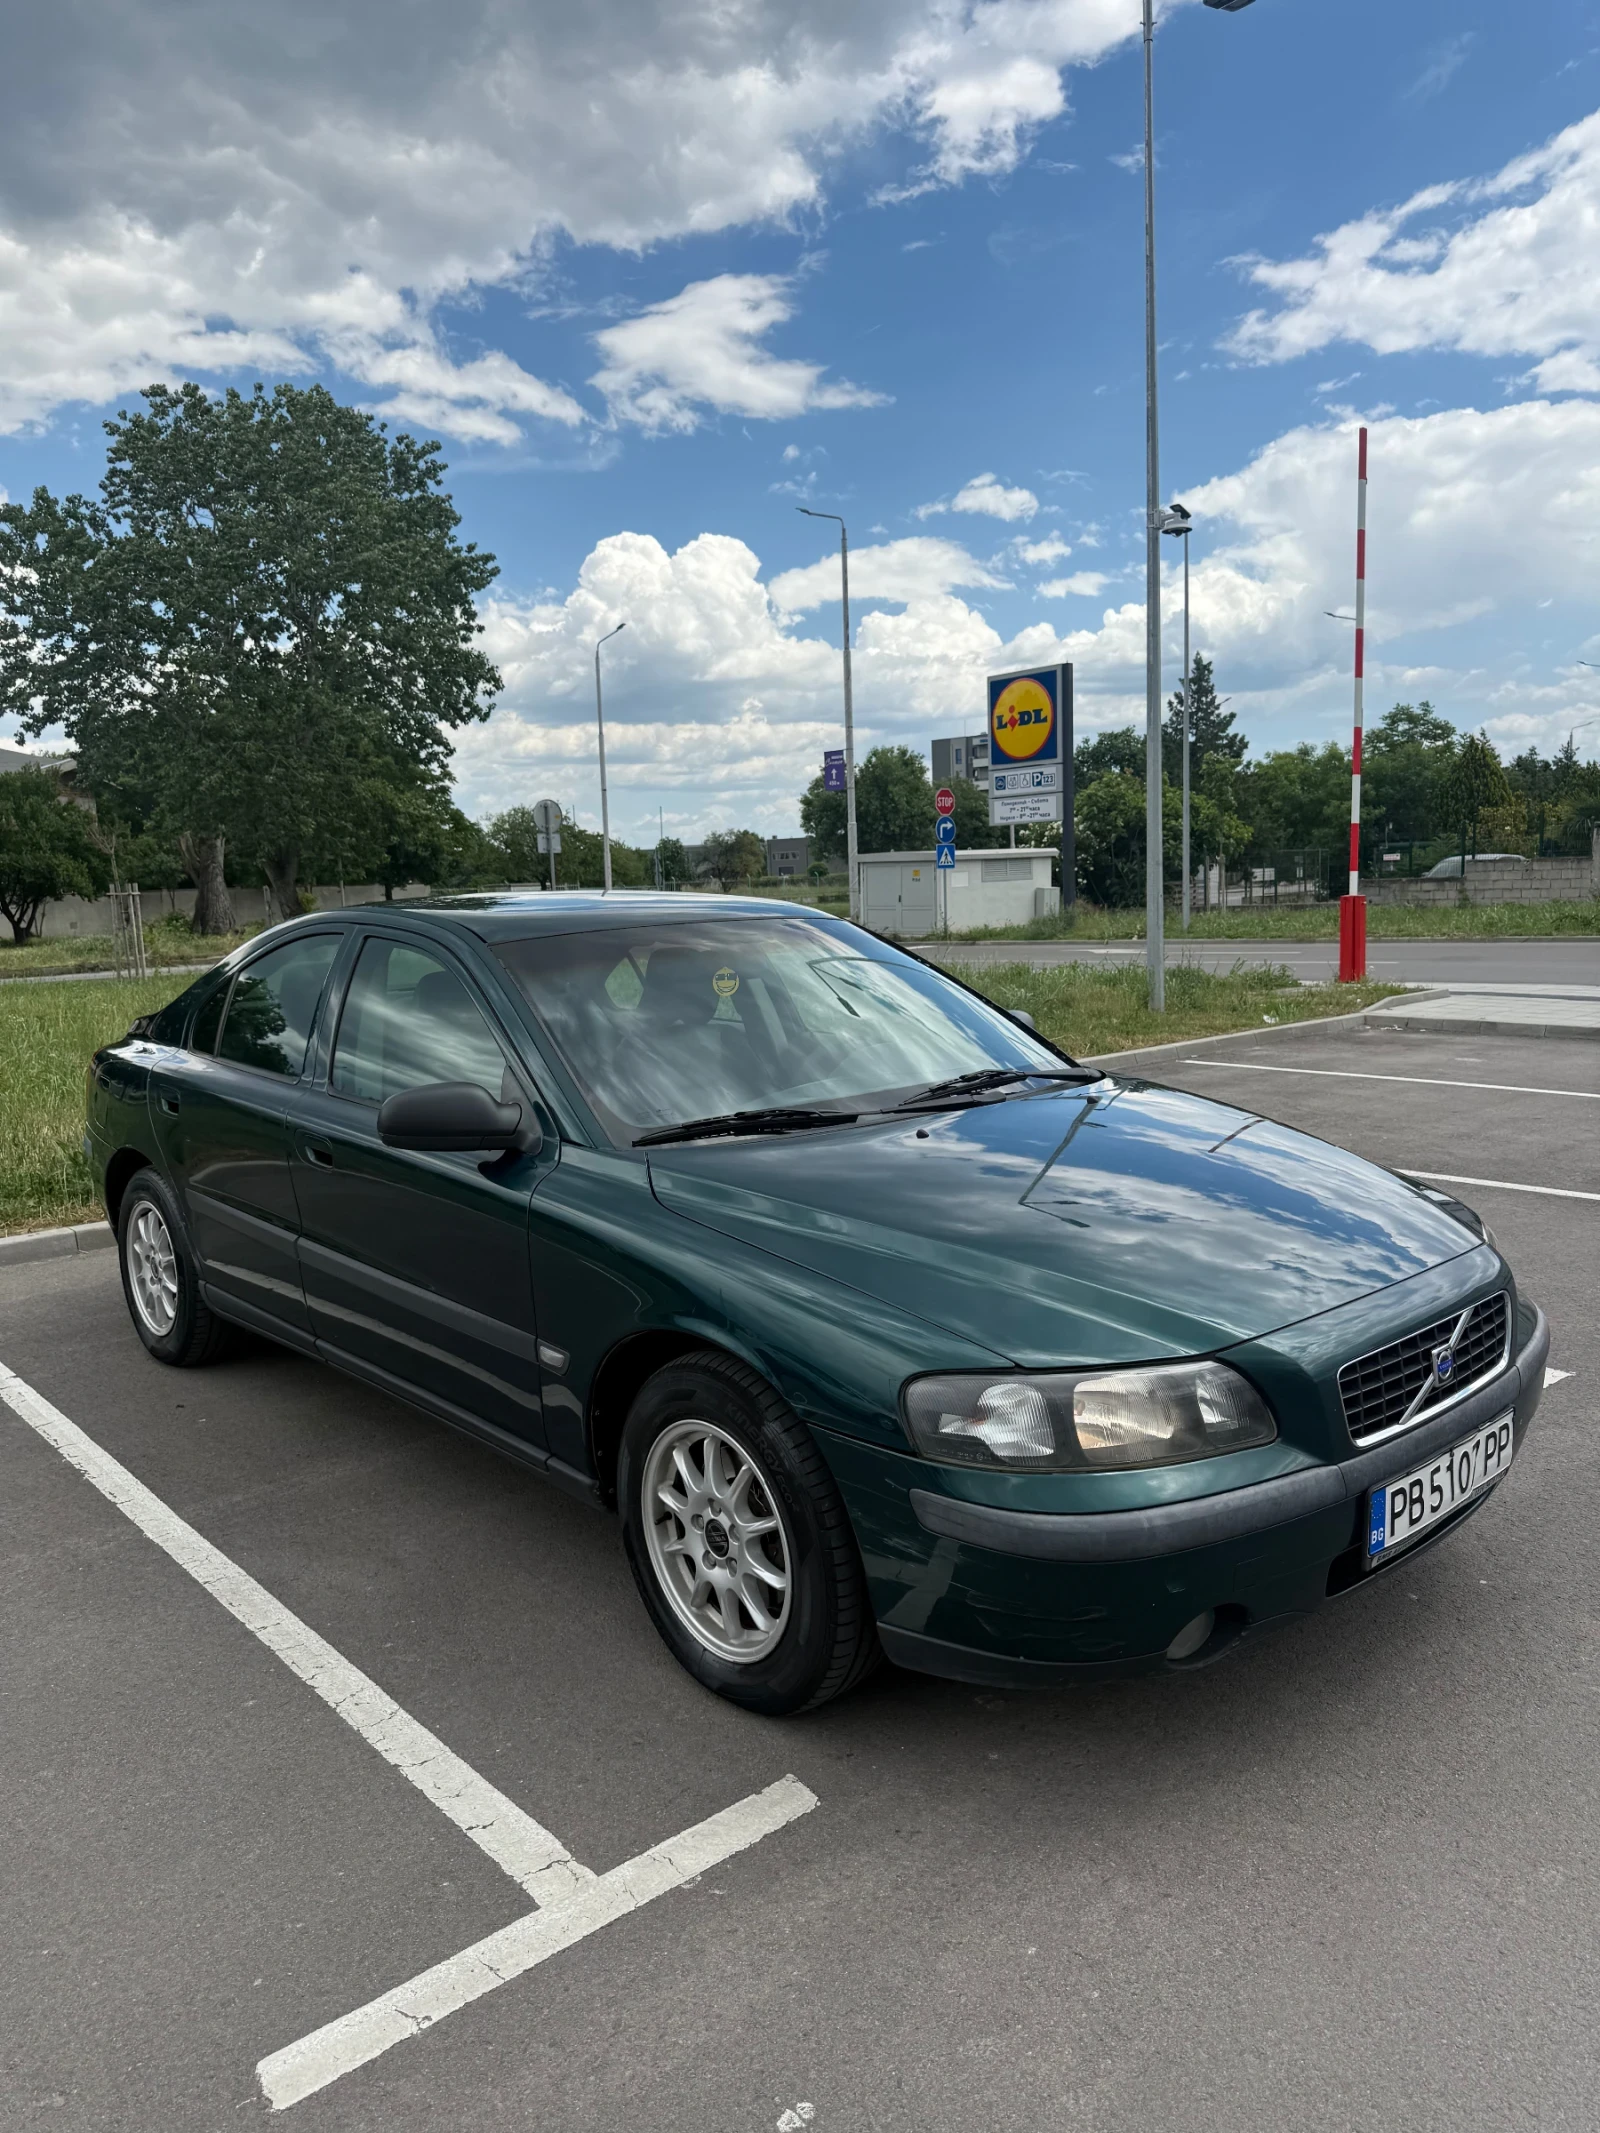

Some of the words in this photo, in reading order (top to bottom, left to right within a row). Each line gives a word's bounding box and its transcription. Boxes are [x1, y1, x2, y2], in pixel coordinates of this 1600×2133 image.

[1033, 773, 1041, 786] P
[937, 797, 953, 807] STOP
[1371, 1527, 1384, 1545] BG
